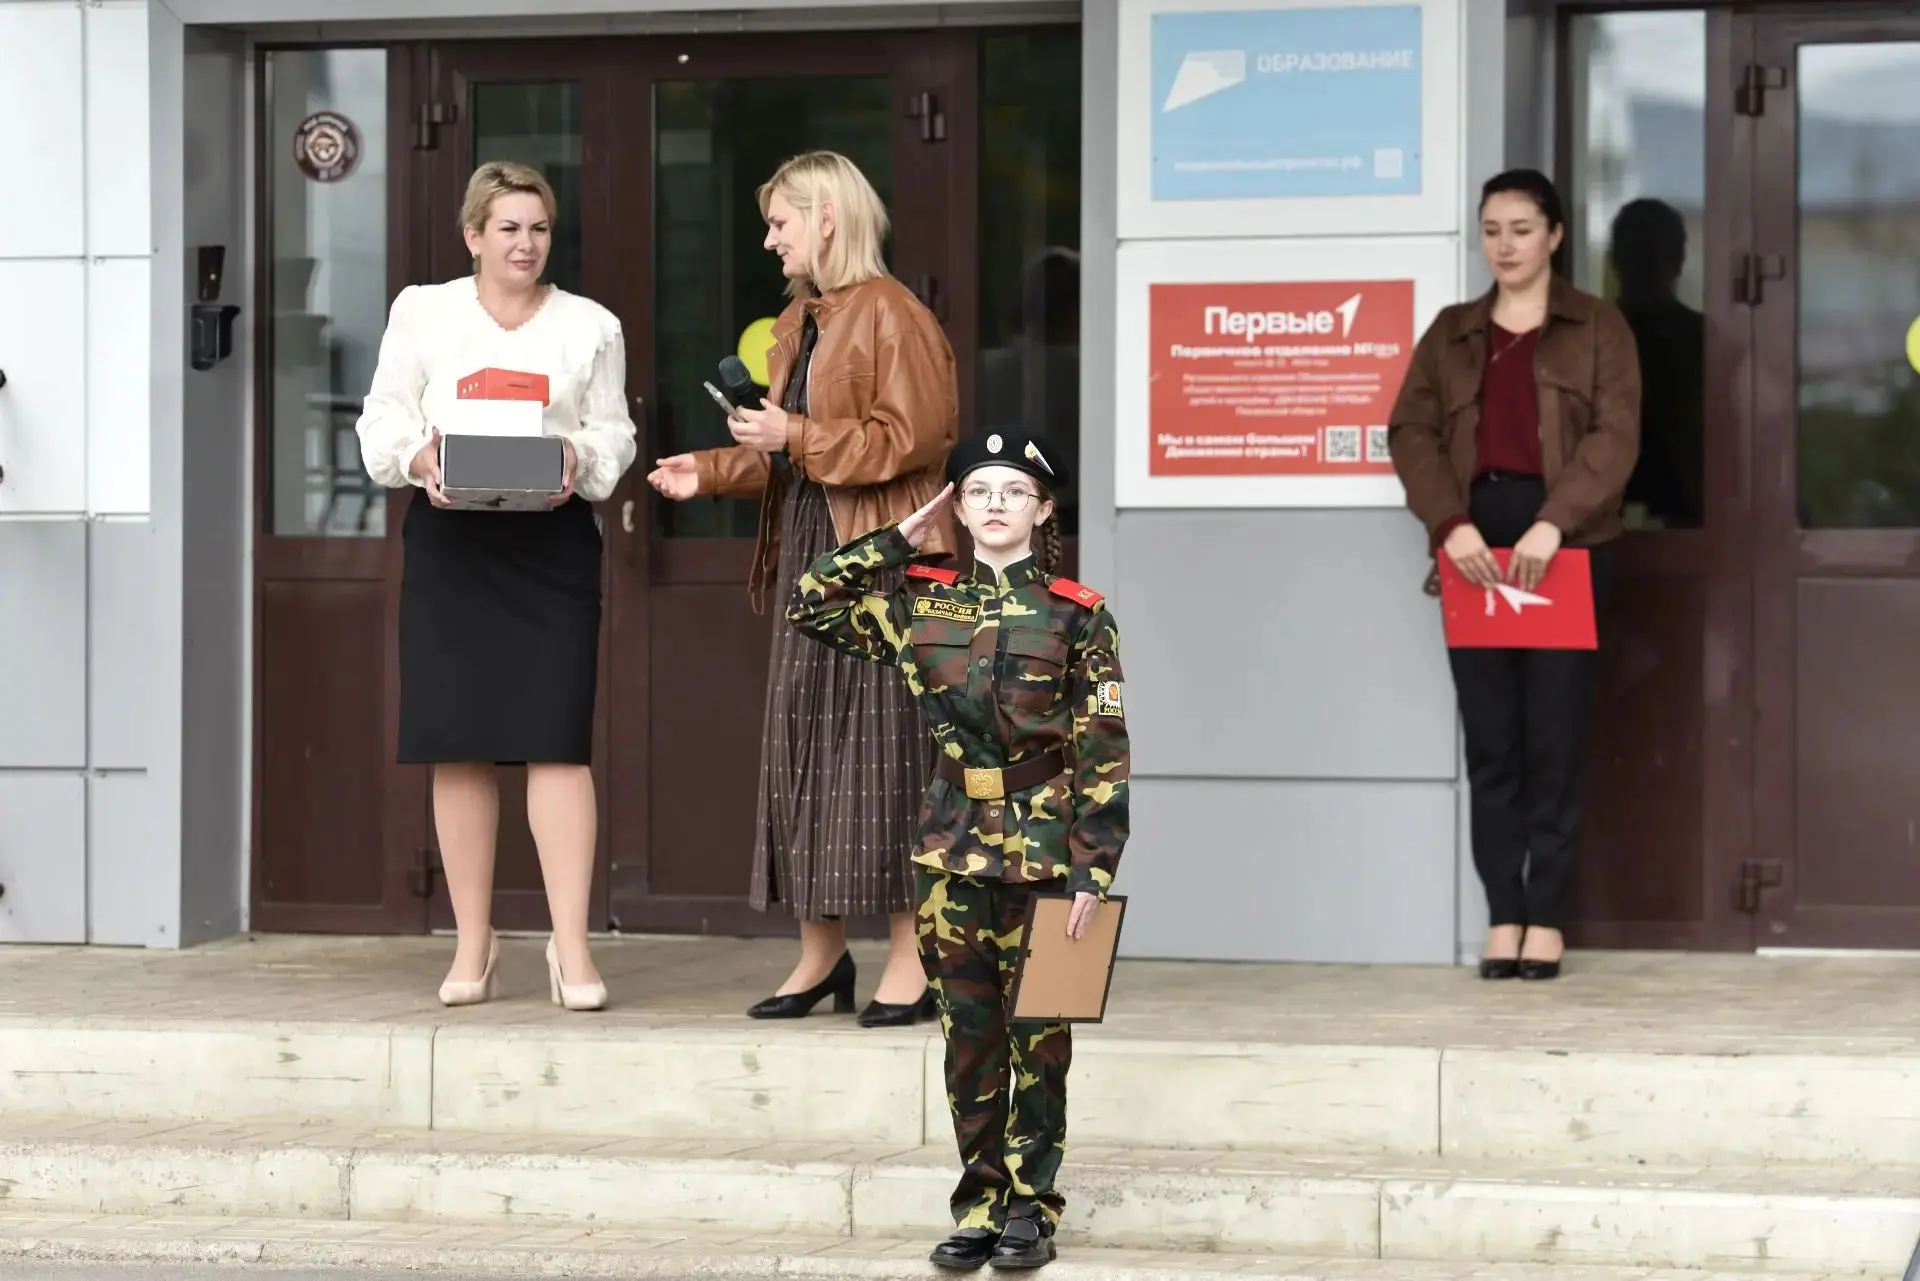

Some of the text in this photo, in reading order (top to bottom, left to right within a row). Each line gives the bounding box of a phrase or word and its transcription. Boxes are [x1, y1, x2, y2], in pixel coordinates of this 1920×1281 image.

[1257, 49, 1414, 73] ОБРАЗОВАНИЕ
[1204, 306, 1335, 343] Первые
[934, 602, 973, 615] РОССИЯ
